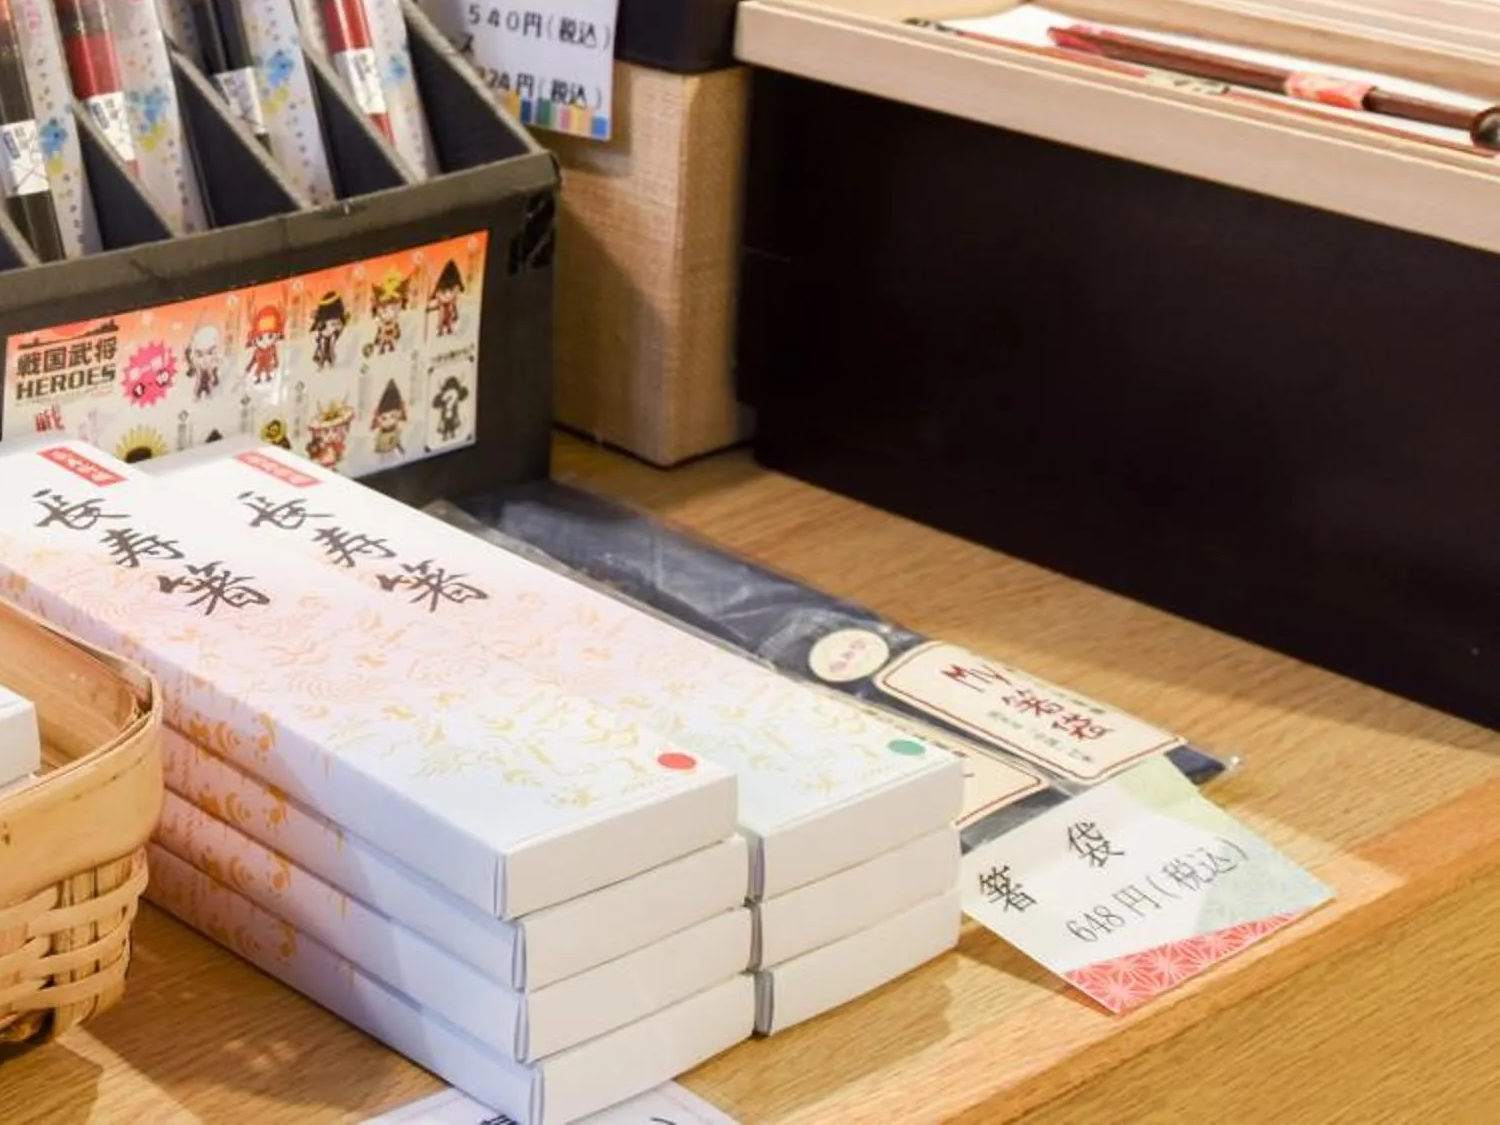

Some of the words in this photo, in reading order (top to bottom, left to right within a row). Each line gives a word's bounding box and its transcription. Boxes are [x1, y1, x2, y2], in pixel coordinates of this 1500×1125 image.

[15, 362, 116, 401] HEROES
[16, 335, 118, 376] 戦国武将
[30, 487, 272, 617] 長寿箸
[236, 489, 491, 614] 長寿箸
[1064, 835, 1249, 946] 648円(税込)
